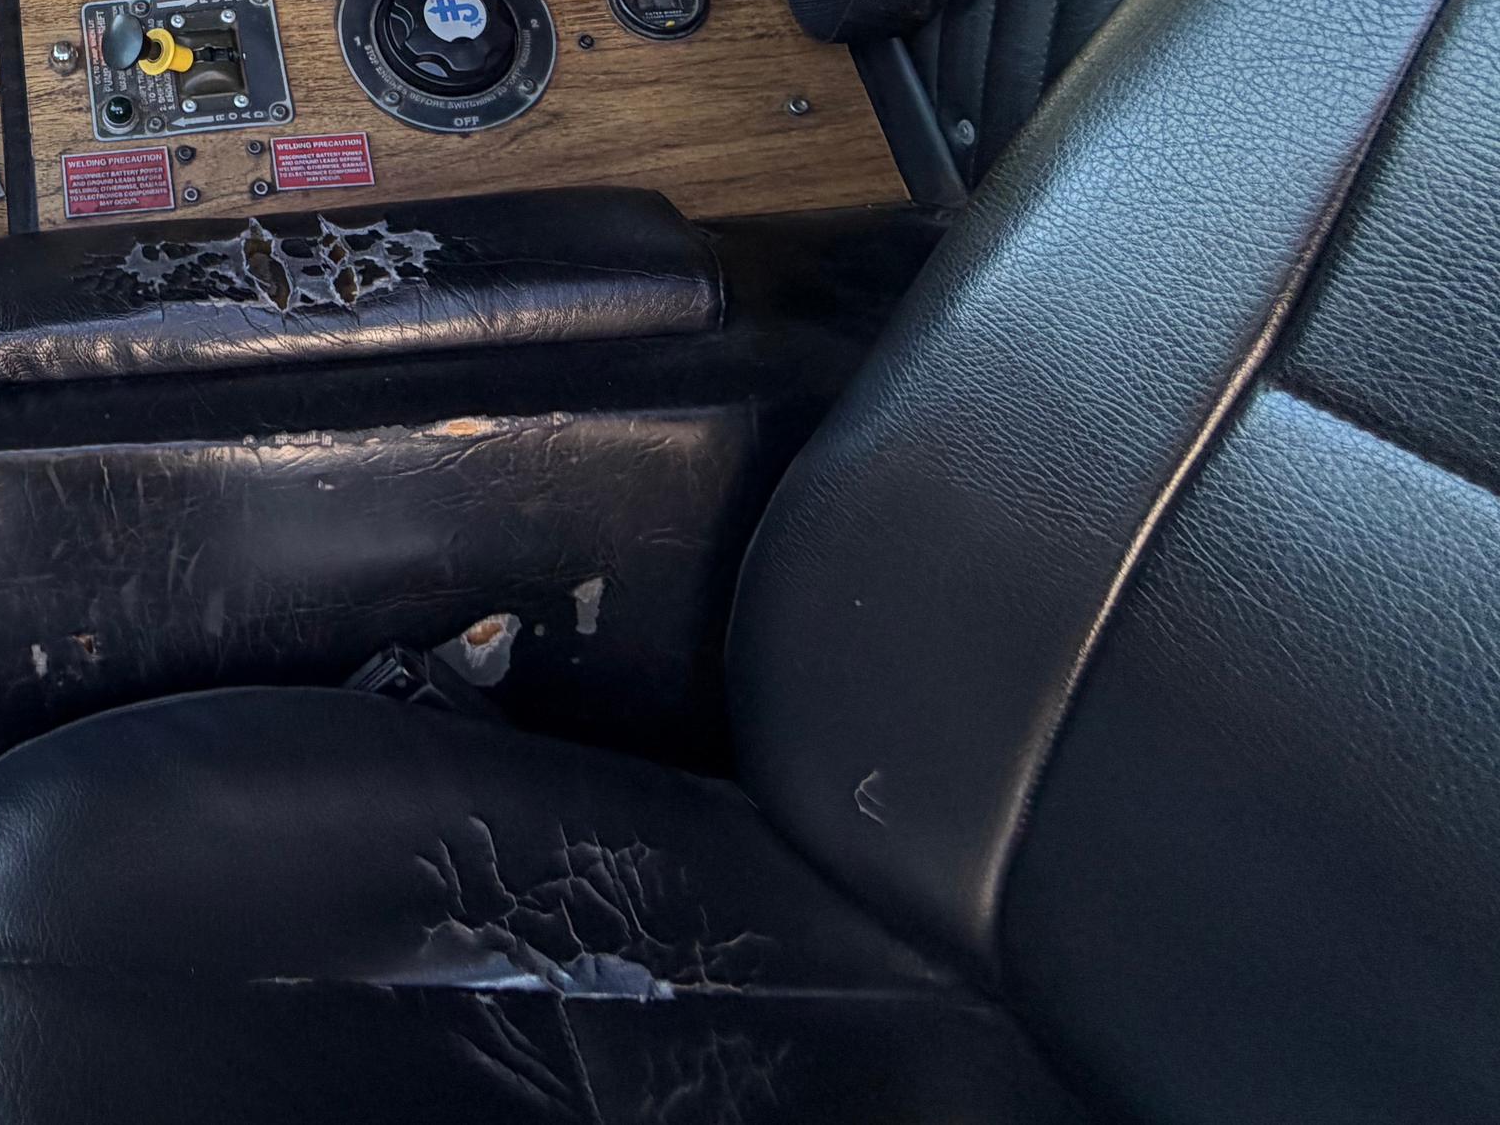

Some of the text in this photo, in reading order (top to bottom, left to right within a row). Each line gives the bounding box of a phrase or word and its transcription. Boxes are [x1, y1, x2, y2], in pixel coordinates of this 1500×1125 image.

[364, 44, 379, 65] STOP
[409, 91, 445, 109] BEFORE
[446, 93, 496, 110] SWITCHING
[454, 115, 480, 127] OFF
[276, 139, 362, 150] WELDING PRECAUTION
[68, 153, 162, 169] WELDING PRECAUTION
[70, 171, 109, 180] DISCONNECT
[110, 169, 139, 177] BATTERY
[86, 178, 114, 186] GROUND
[114, 176, 136, 184] LEADS
